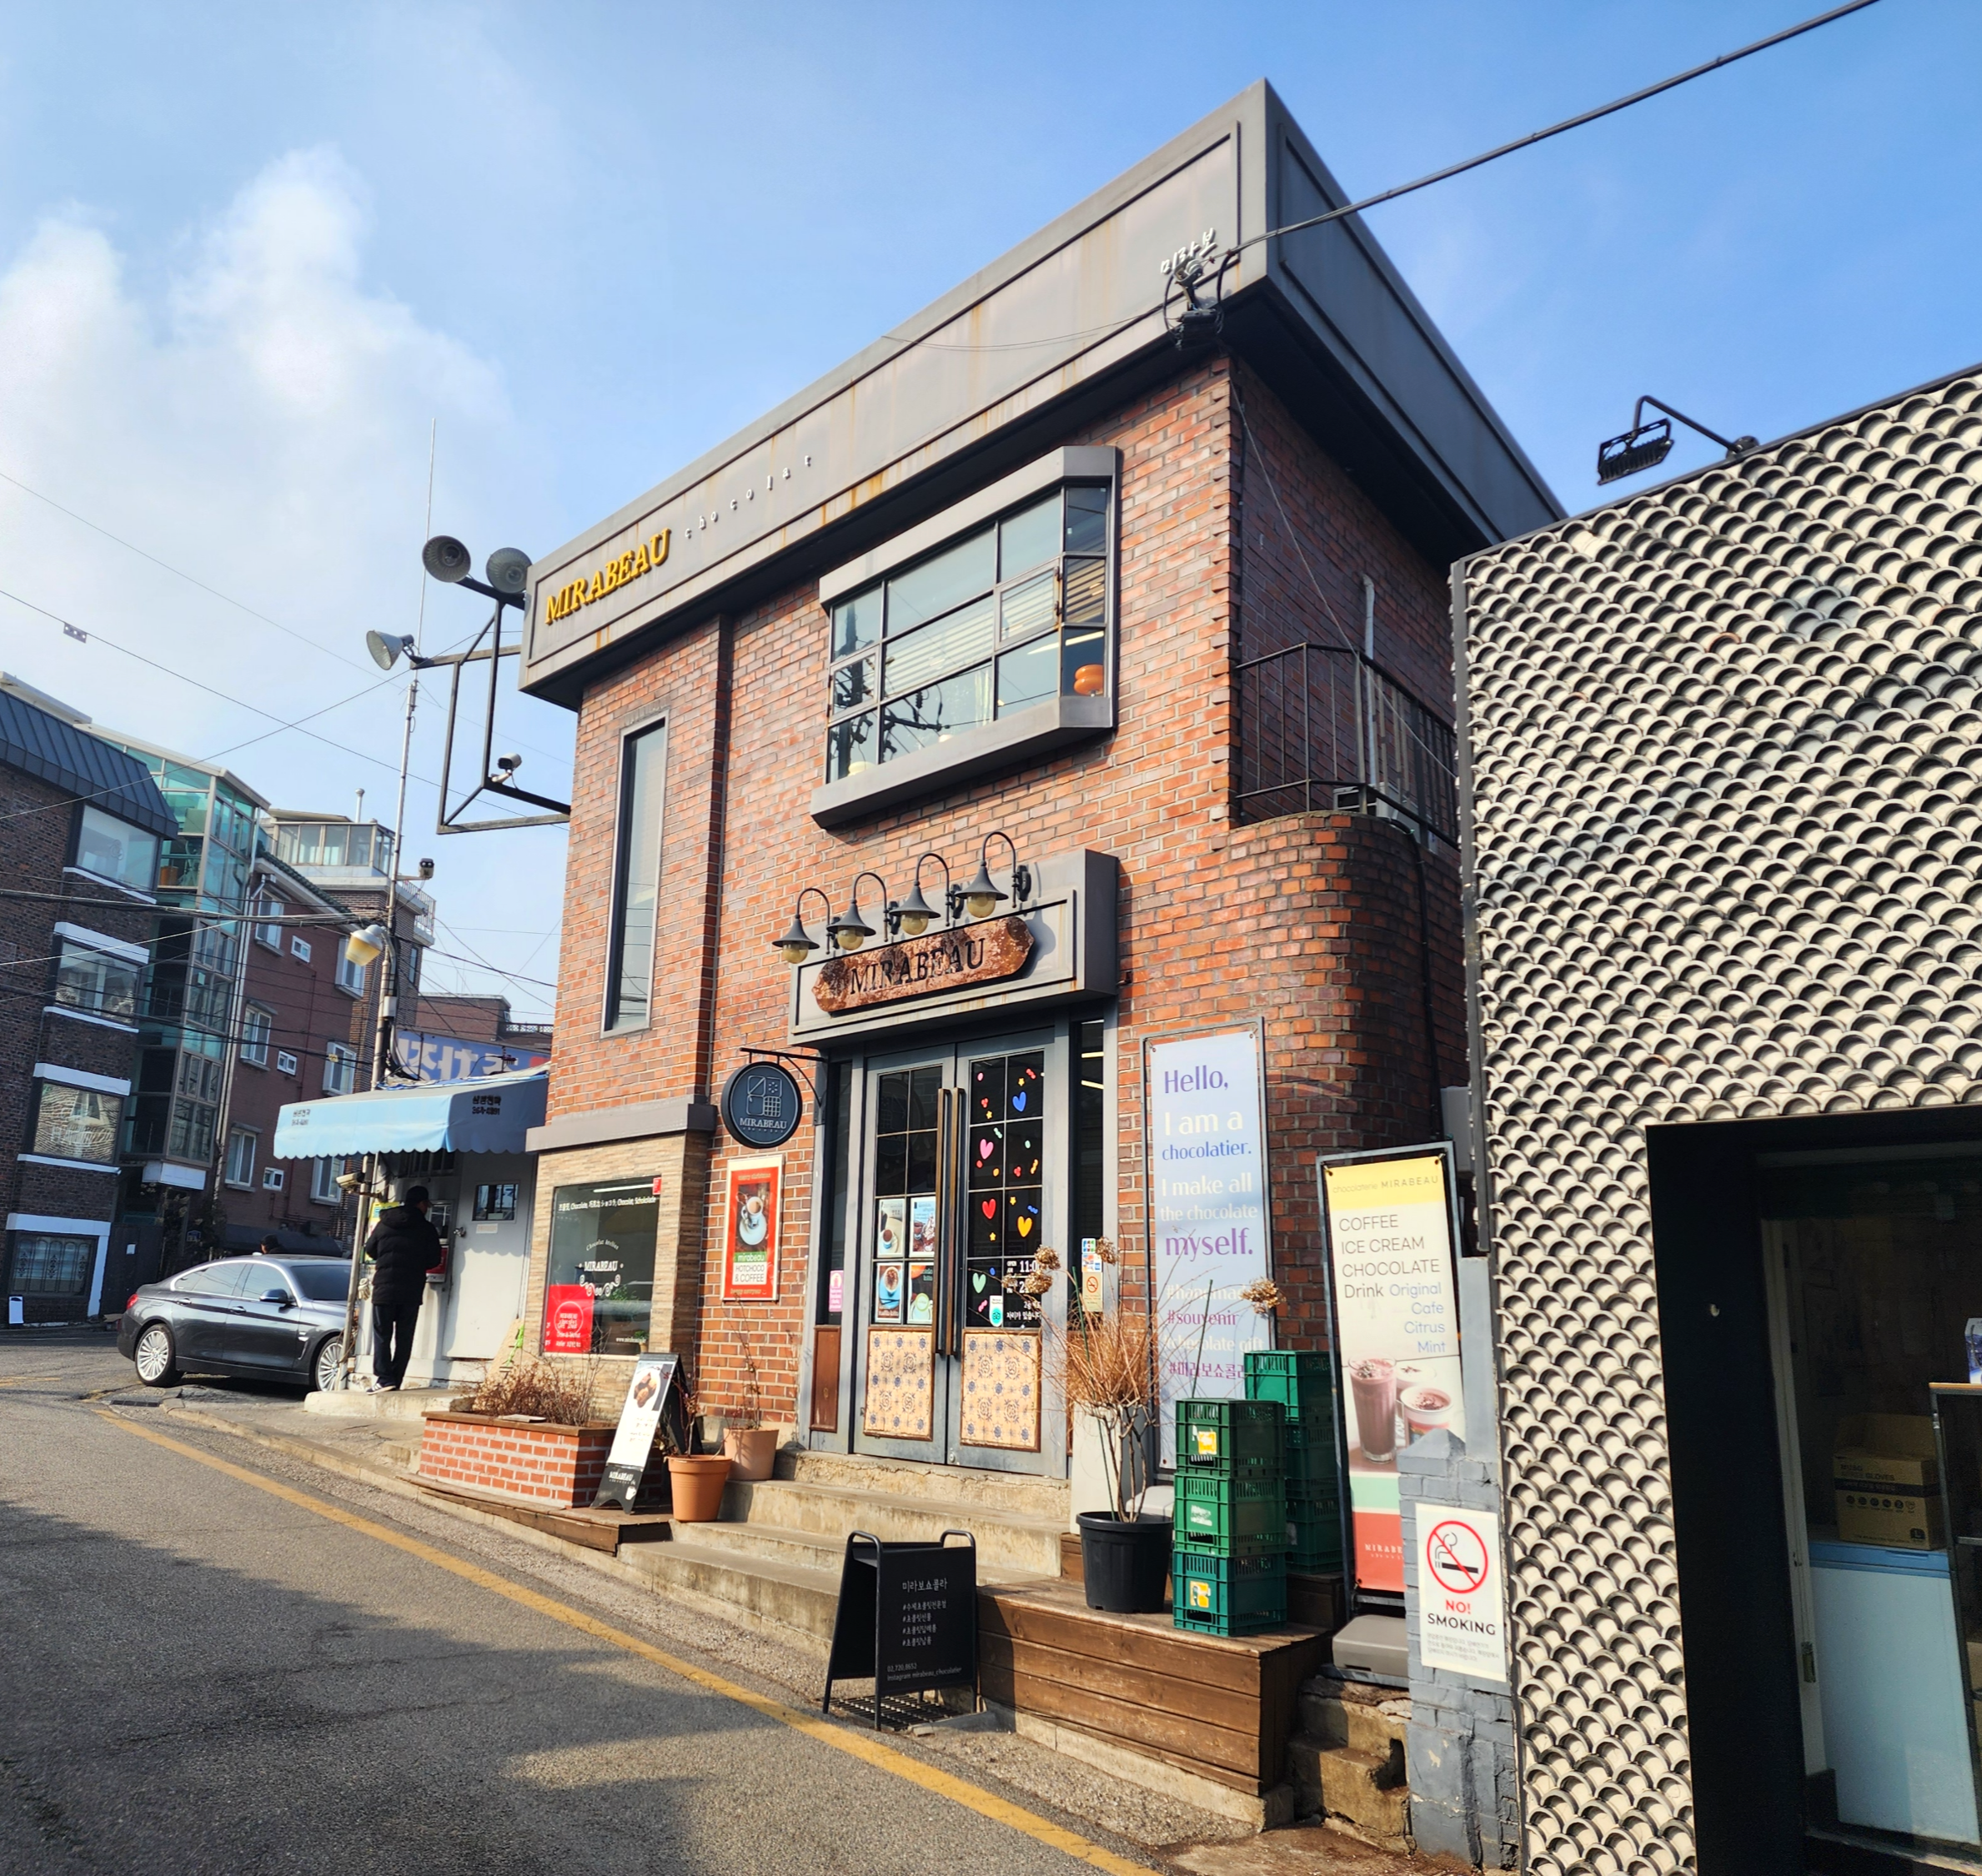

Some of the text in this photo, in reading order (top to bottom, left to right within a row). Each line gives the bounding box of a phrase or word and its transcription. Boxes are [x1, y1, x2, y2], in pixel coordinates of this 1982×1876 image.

[544, 454, 812, 625] MIRABEAU chocolat
[850, 937, 986, 995] MIRABEAU
[1164, 1065, 1228, 1093] Hello,
[739, 1117, 787, 1129] MIRABEAU
[1165, 1111, 1243, 1136] I am a
[1162, 1140, 1252, 1161] chocolatier.
[1162, 1171, 1252, 1196] I make all
[1381, 1175, 1438, 1189] MIRABEAU
[1161, 1203, 1258, 1221] the chocolate
[1339, 1214, 1399, 1231] COFFEE
[1166, 1227, 1253, 1262] myself.
[1341, 1236, 1425, 1254] ICE CREAM
[737, 1252, 765, 1262] mirabeau
[584, 1261, 619, 1272] MIRABEAU
[735, 1264, 765, 1272] HOTCHOCO
[1342, 1258, 1441, 1277] CHOCOLATE
[740, 1273, 765, 1282] COFFEE
[1167, 1283, 1254, 1301] #handmad
[1344, 1282, 1442, 1298] Drink Original
[1412, 1302, 1444, 1315] Cafe
[1167, 1309, 1239, 1326] #souvenir
[1404, 1321, 1445, 1334] Citrus
[1239, 1337, 1264, 1355] gift
[1418, 1341, 1446, 1353] Mint
[1364, 1542, 1403, 1554] MIRABE
[902, 1578, 948, 1593] 미라보쇼콜라
[1445, 1599, 1471, 1615] NO!
[1428, 1613, 1496, 1635] SMOKING
